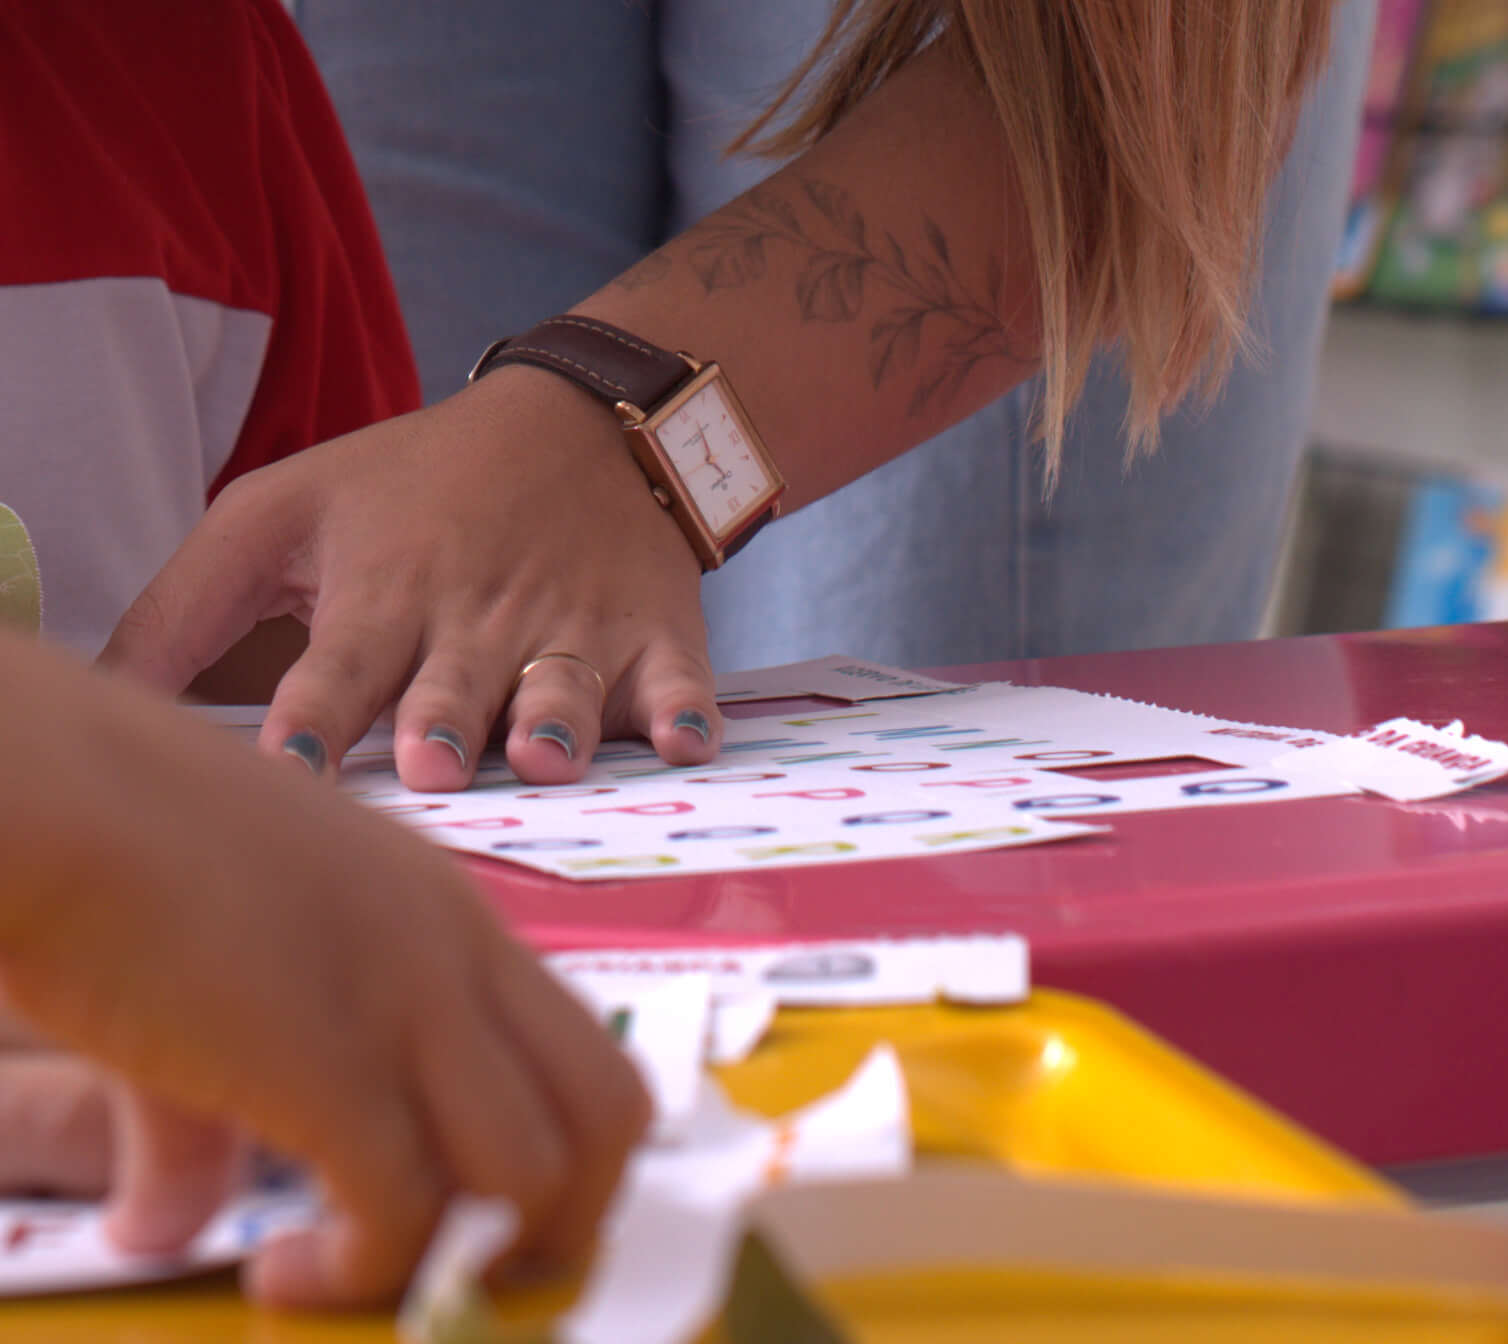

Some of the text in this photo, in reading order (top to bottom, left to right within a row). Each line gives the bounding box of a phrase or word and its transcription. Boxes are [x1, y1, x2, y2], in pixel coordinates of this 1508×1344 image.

[1013, 749, 1115, 761] O
[684, 772, 788, 784] O
[752, 787, 867, 801] P
[850, 761, 952, 773] O
[920, 776, 1032, 789] P
[516, 787, 619, 800] O
[582, 800, 696, 816] P
[414, 816, 524, 831] P
